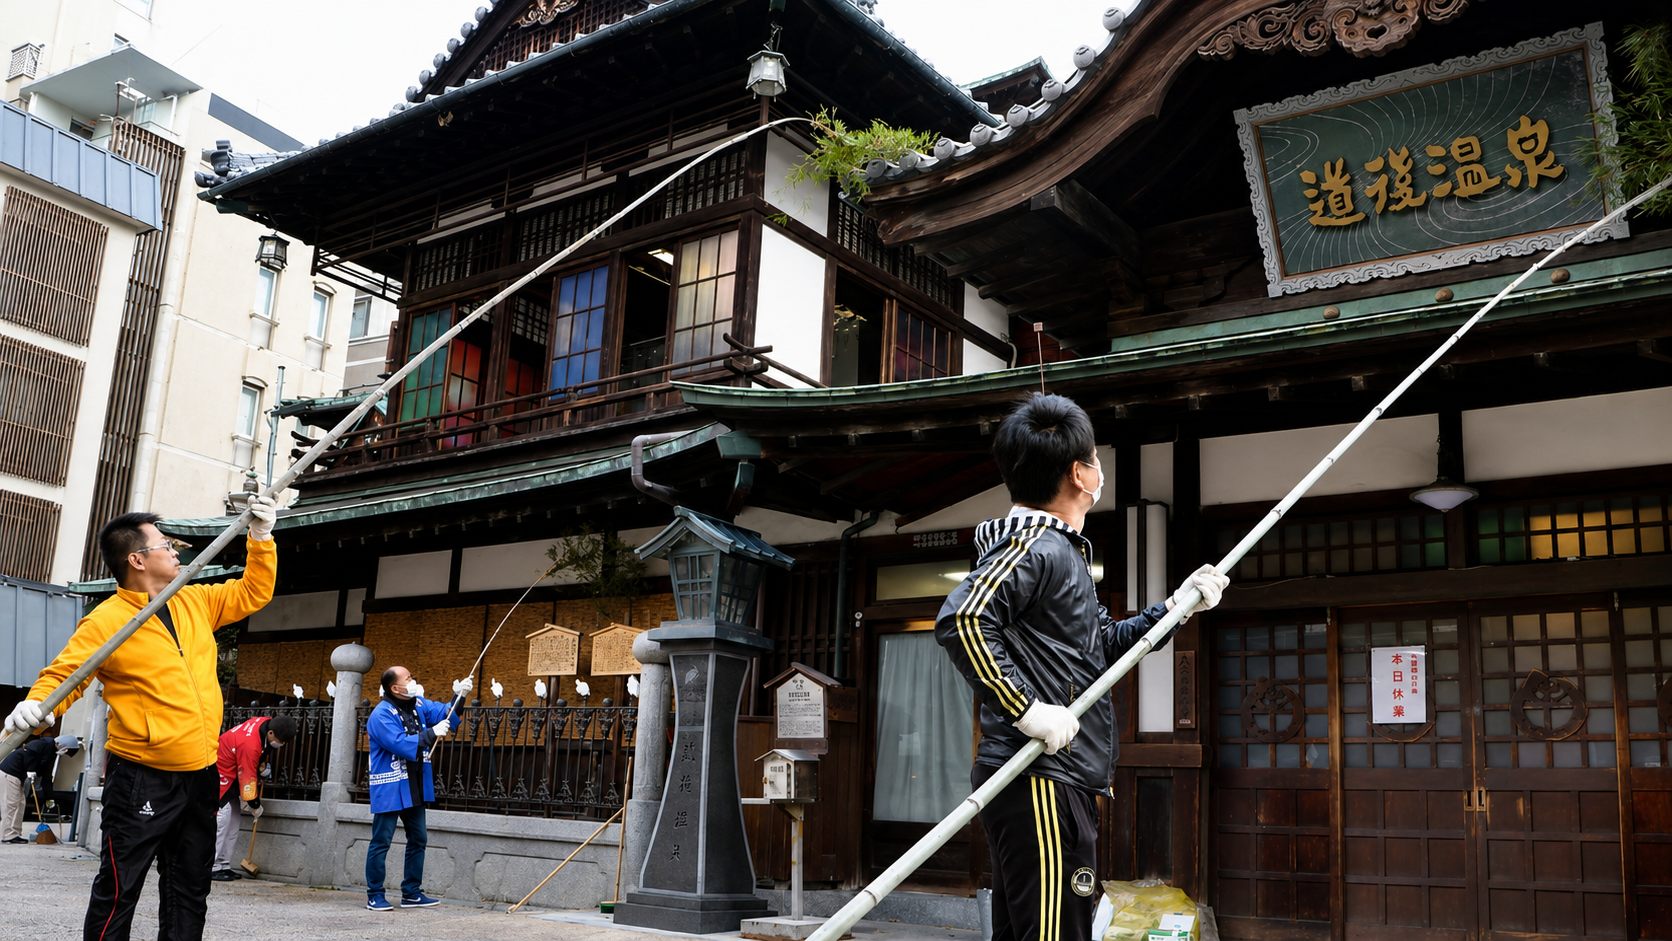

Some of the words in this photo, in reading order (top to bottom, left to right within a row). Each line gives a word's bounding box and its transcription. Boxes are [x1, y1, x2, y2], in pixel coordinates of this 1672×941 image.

[1299, 114, 1565, 227] 道後温泉
[1391, 653, 1405, 718] 本日休業
